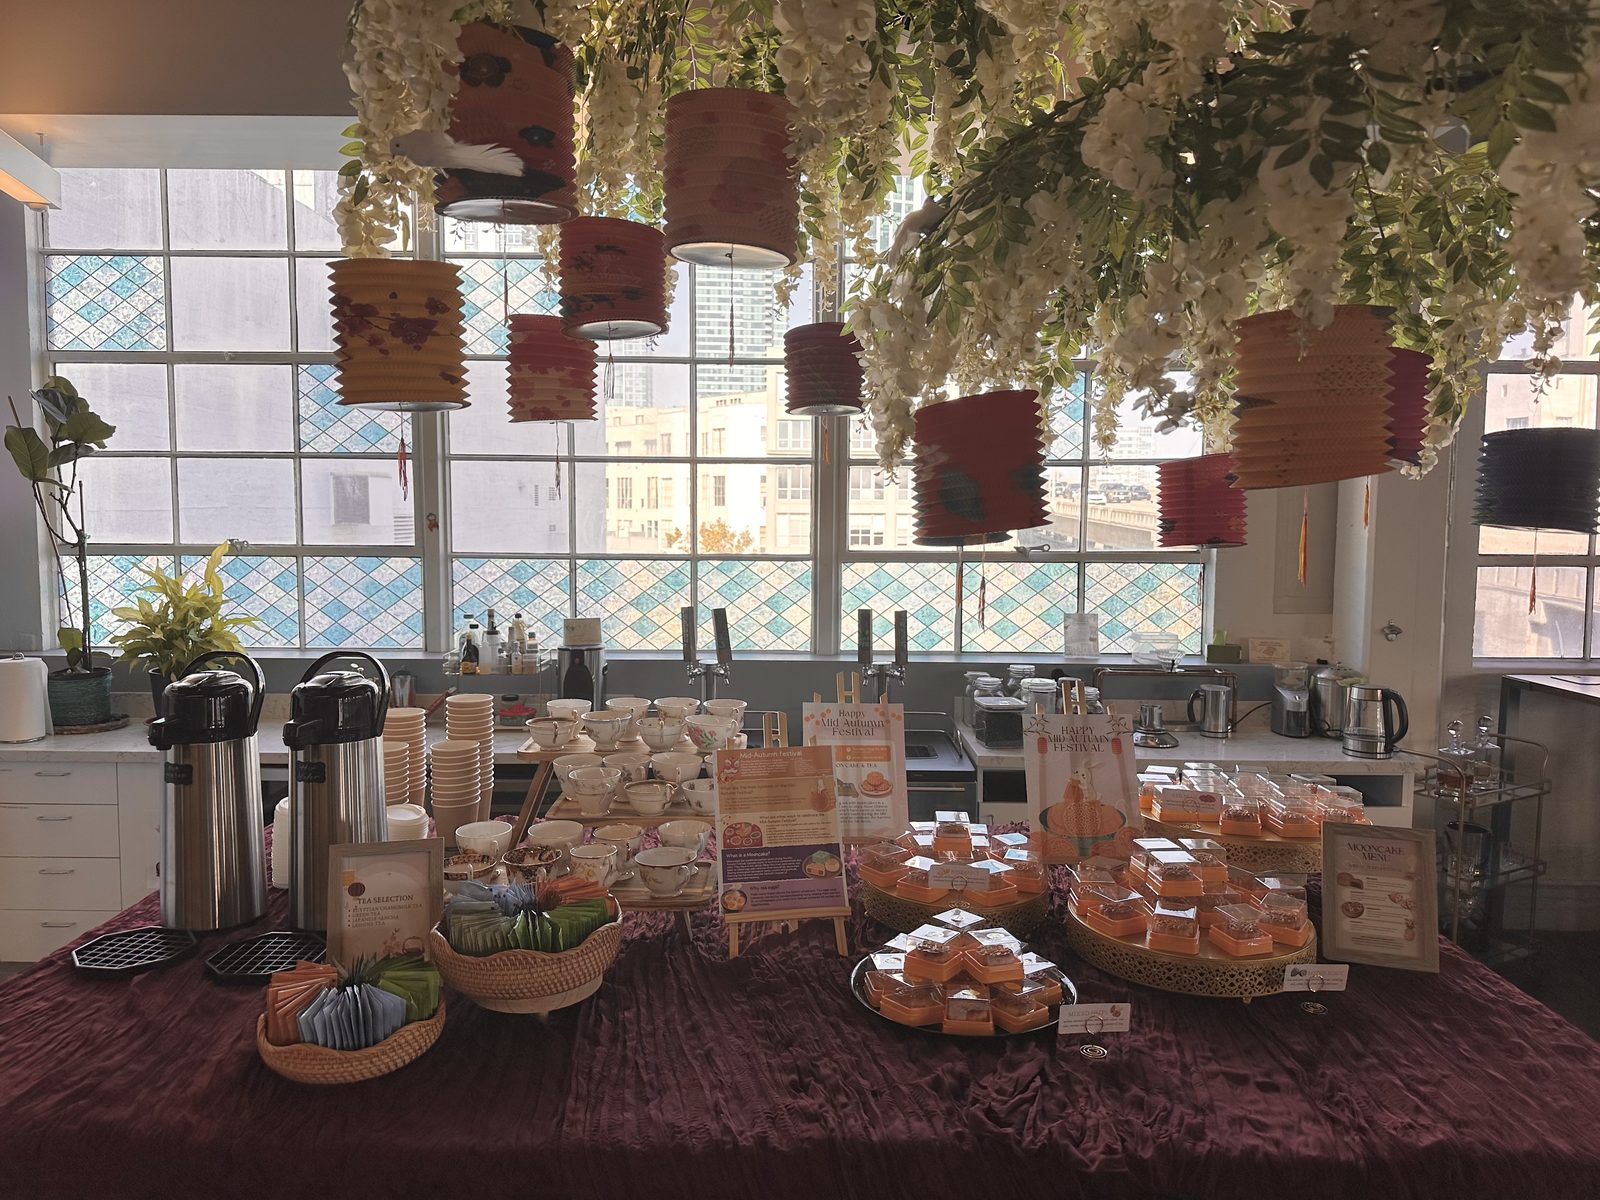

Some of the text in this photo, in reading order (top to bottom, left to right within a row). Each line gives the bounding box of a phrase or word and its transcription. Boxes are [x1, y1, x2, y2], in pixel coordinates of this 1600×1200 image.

[838, 710, 865, 718] Happy
[832, 728, 874, 736] Festival
[1061, 726, 1094, 734] HAPPY
[1054, 744, 1104, 752] FESTIVAL
[1348, 843, 1405, 856] MOONCAKE
[1362, 852, 1390, 862] MENU
[373, 895, 414, 903] SELECTION
